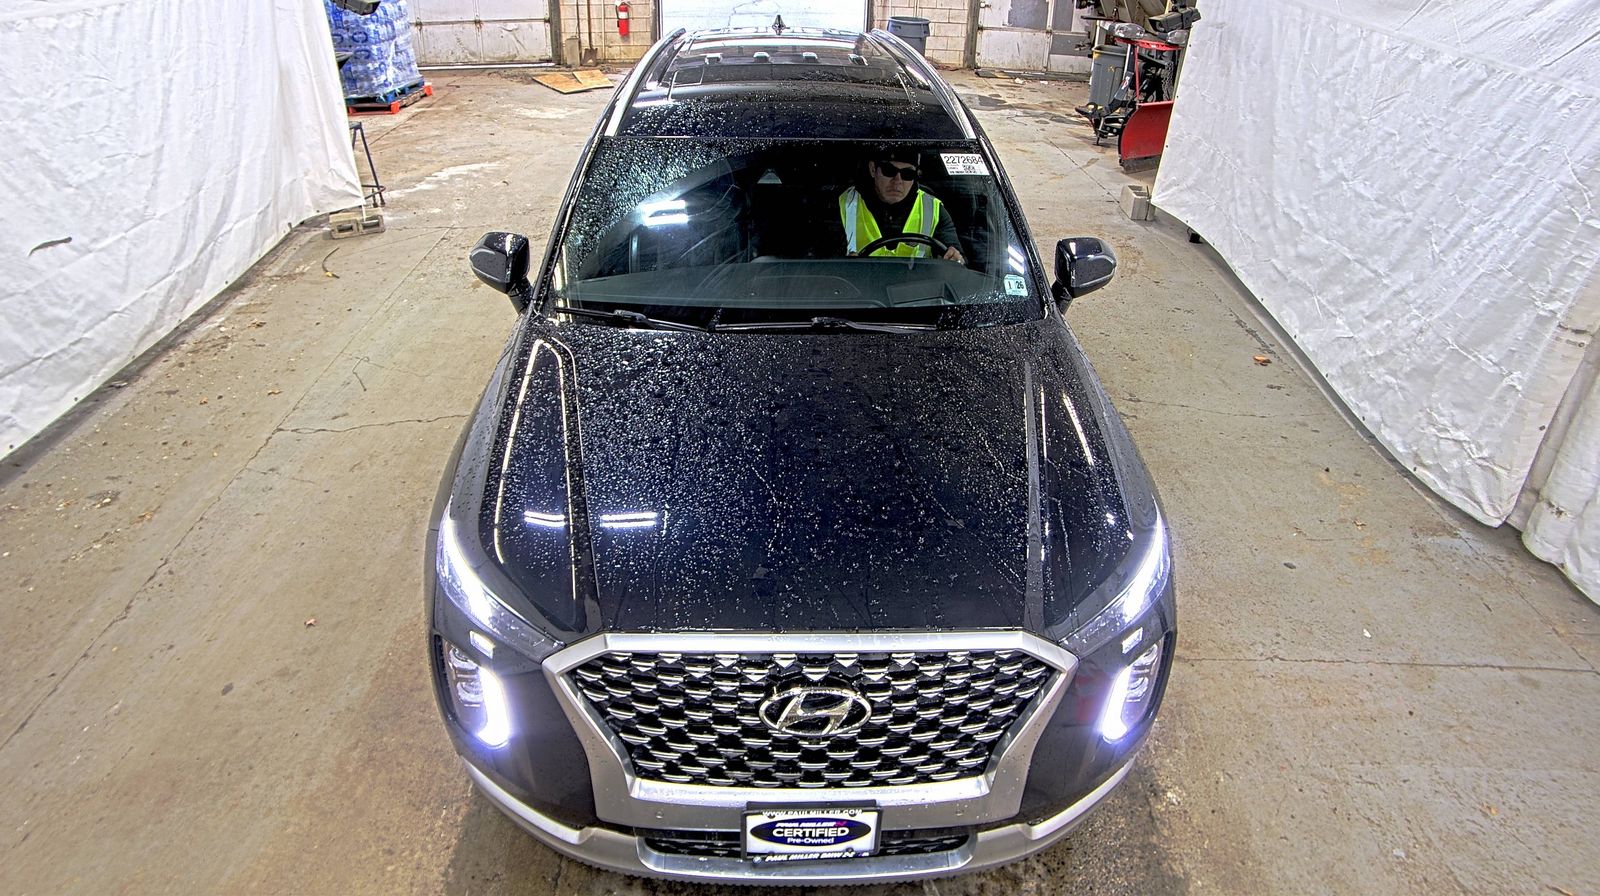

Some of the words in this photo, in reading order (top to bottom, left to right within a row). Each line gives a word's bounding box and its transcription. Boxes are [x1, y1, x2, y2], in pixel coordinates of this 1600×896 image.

[1016, 281, 1024, 289] 26
[772, 827, 849, 837] CERTIFIED
[765, 854, 788, 862] PAUL
